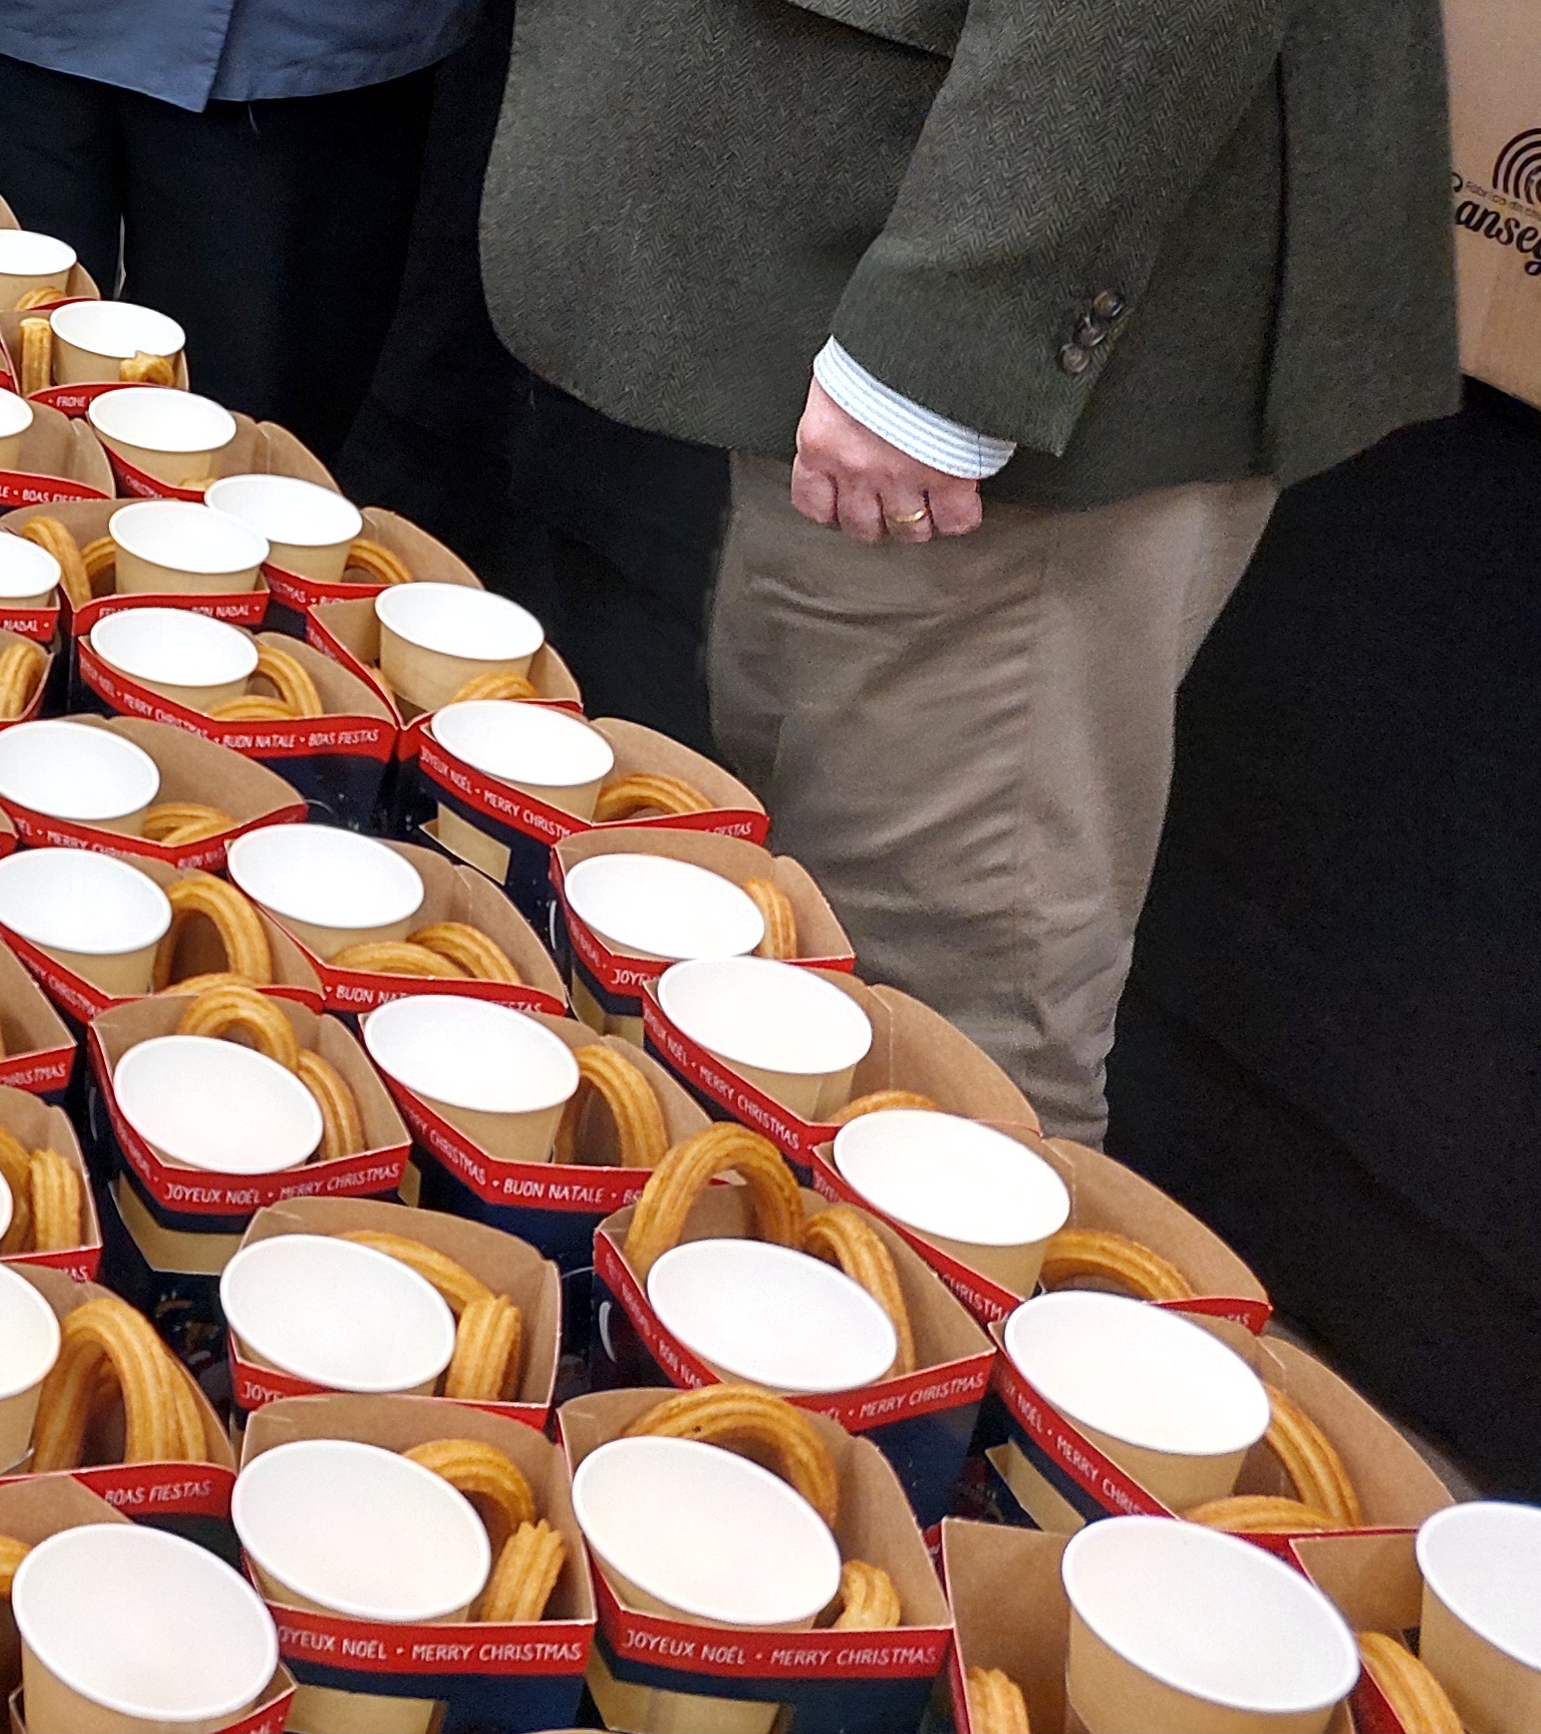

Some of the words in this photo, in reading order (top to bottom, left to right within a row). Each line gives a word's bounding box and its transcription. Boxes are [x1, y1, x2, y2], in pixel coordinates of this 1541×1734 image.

[307, 731, 336, 747] BOAS
[337, 728, 380, 745] FIESTAS
[482, 789, 520, 819] MERRY
[522, 807, 574, 840] CHRISTM
[336, 984, 375, 1005] BUON
[699, 1065, 735, 1104] MERRY
[736, 1093, 800, 1152] CHRISTMAS
[165, 1182, 222, 1203] JOYEUX
[224, 1188, 261, 1205] NOËL
[278, 1180, 323, 1200] MERRY
[325, 1164, 401, 1192] CHRISTMAS
[429, 1129, 487, 1186] CHRISTMAS
[503, 1179, 544, 1199] BUON
[547, 1181, 604, 1204] NATALE
[941, 1273, 1006, 1321] CHRISTM
[858, 1394, 903, 1419] MERRY
[907, 1371, 985, 1407] CHRISTMAS
[1056, 1434, 1098, 1483] MERRY
[148, 1479, 215, 1503] FIESTAS
[341, 1638, 387, 1661] NOËL
[411, 1643, 475, 1664] MERRY
[478, 1642, 582, 1662] CHRISTMAS
[621, 1629, 696, 1659] JOYEUX
[700, 1644, 747, 1666] NOËL
[770, 1648, 832, 1667] MERRY
[836, 1647, 937, 1666] CHRISTMAS
